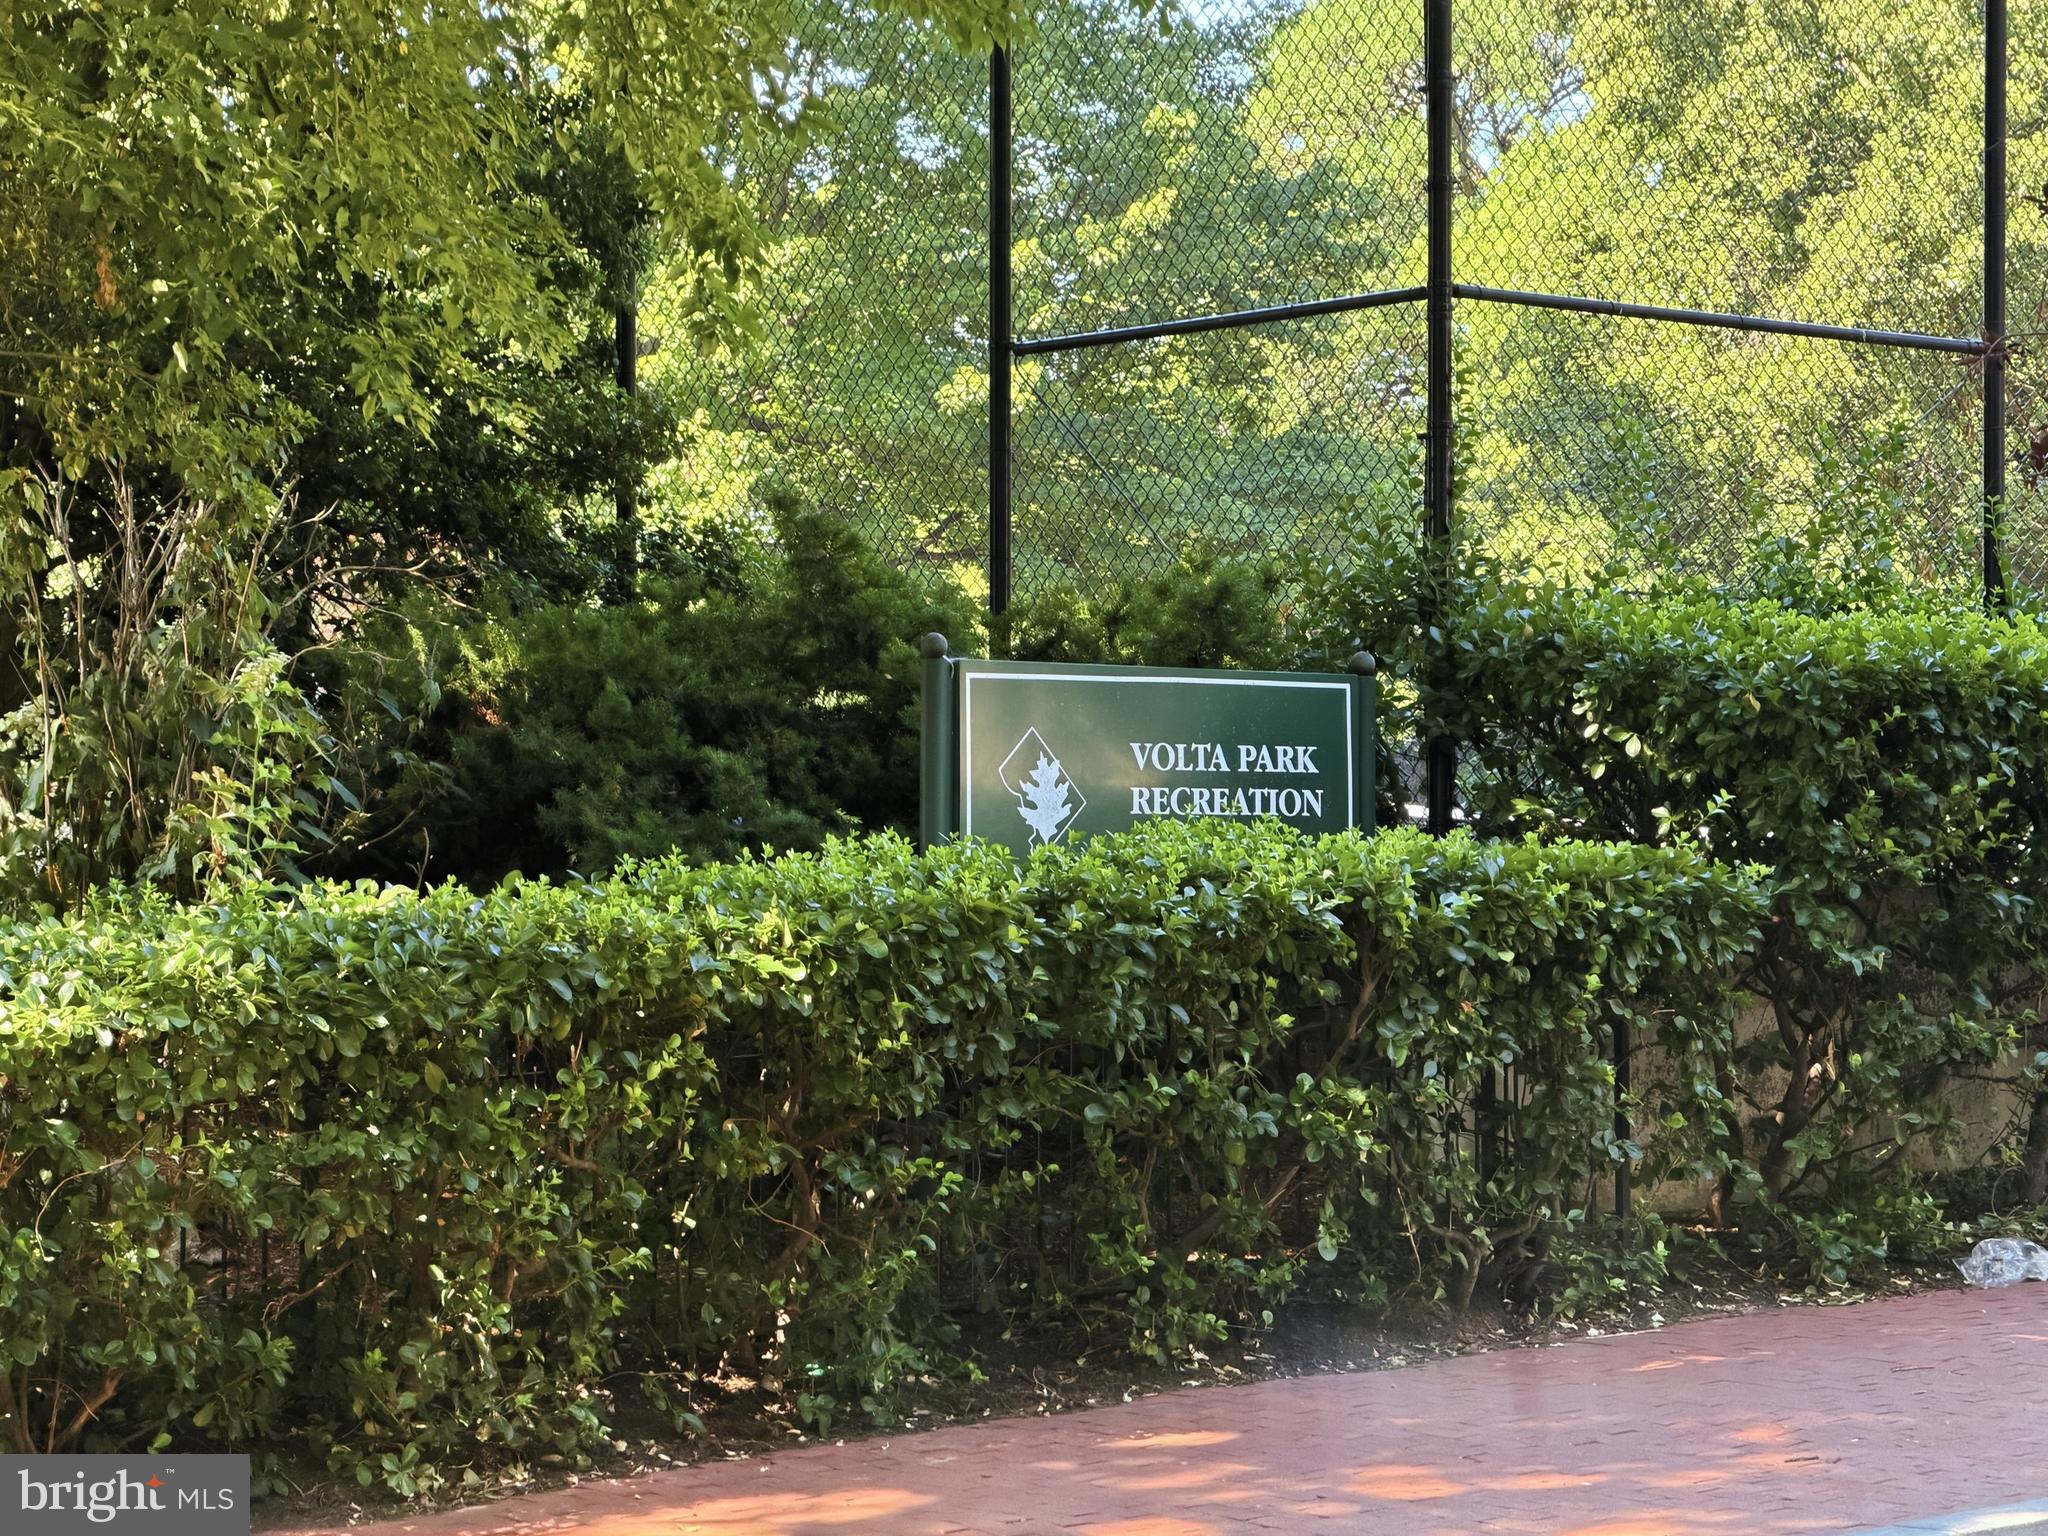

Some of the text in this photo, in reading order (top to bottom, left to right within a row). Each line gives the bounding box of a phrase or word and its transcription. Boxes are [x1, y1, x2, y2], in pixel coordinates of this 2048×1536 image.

[1129, 742, 1320, 774] VOLTA PARK
[1129, 786, 1324, 818] RECREATION
